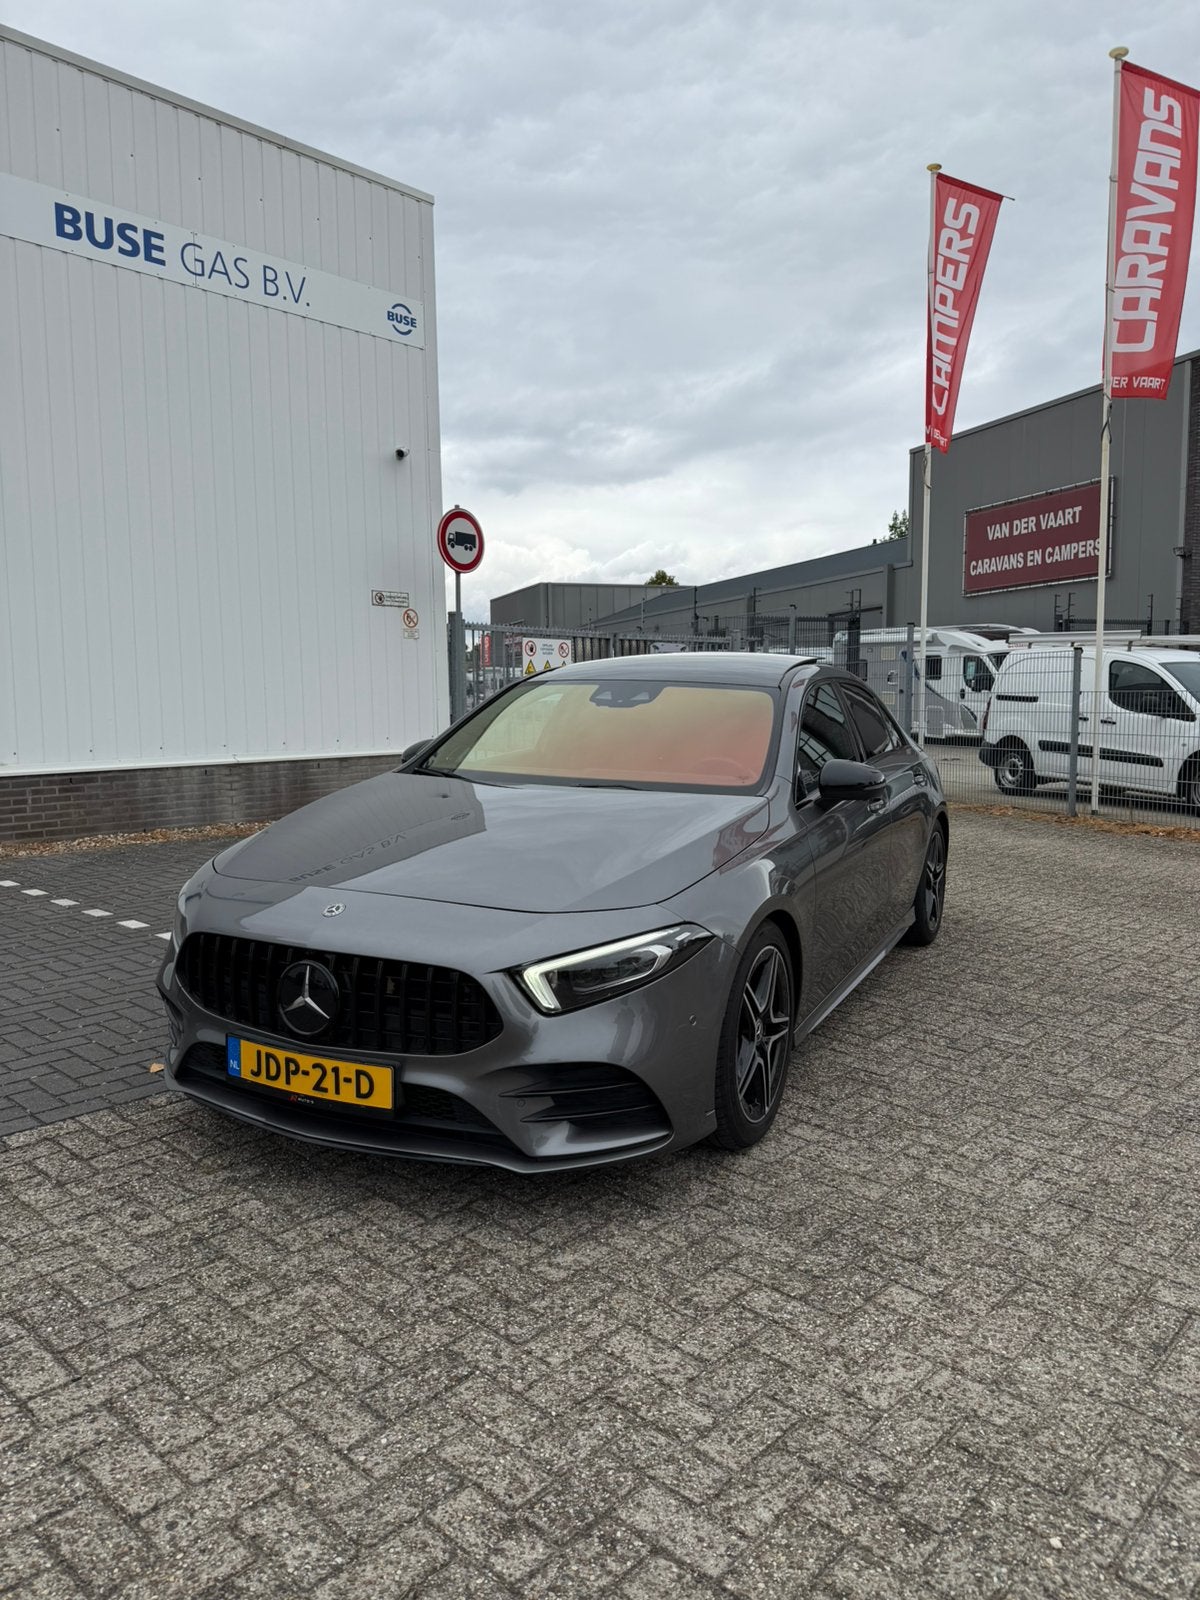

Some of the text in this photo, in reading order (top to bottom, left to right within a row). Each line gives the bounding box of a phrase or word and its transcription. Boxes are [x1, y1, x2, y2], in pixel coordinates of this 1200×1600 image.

[1112, 86, 1183, 353] CARAVANS
[54, 201, 311, 307] BUSE GAS B.V.
[387, 310, 417, 328] BUSE
[931, 196, 981, 416] CAMPERS
[1111, 376, 1166, 391] ER VAART
[987, 505, 1082, 541] VAN DER VAART
[970, 537, 1101, 576] CARAVANS EN CAMPERS
[229, 1049, 375, 1100] NL JDP-21-D
